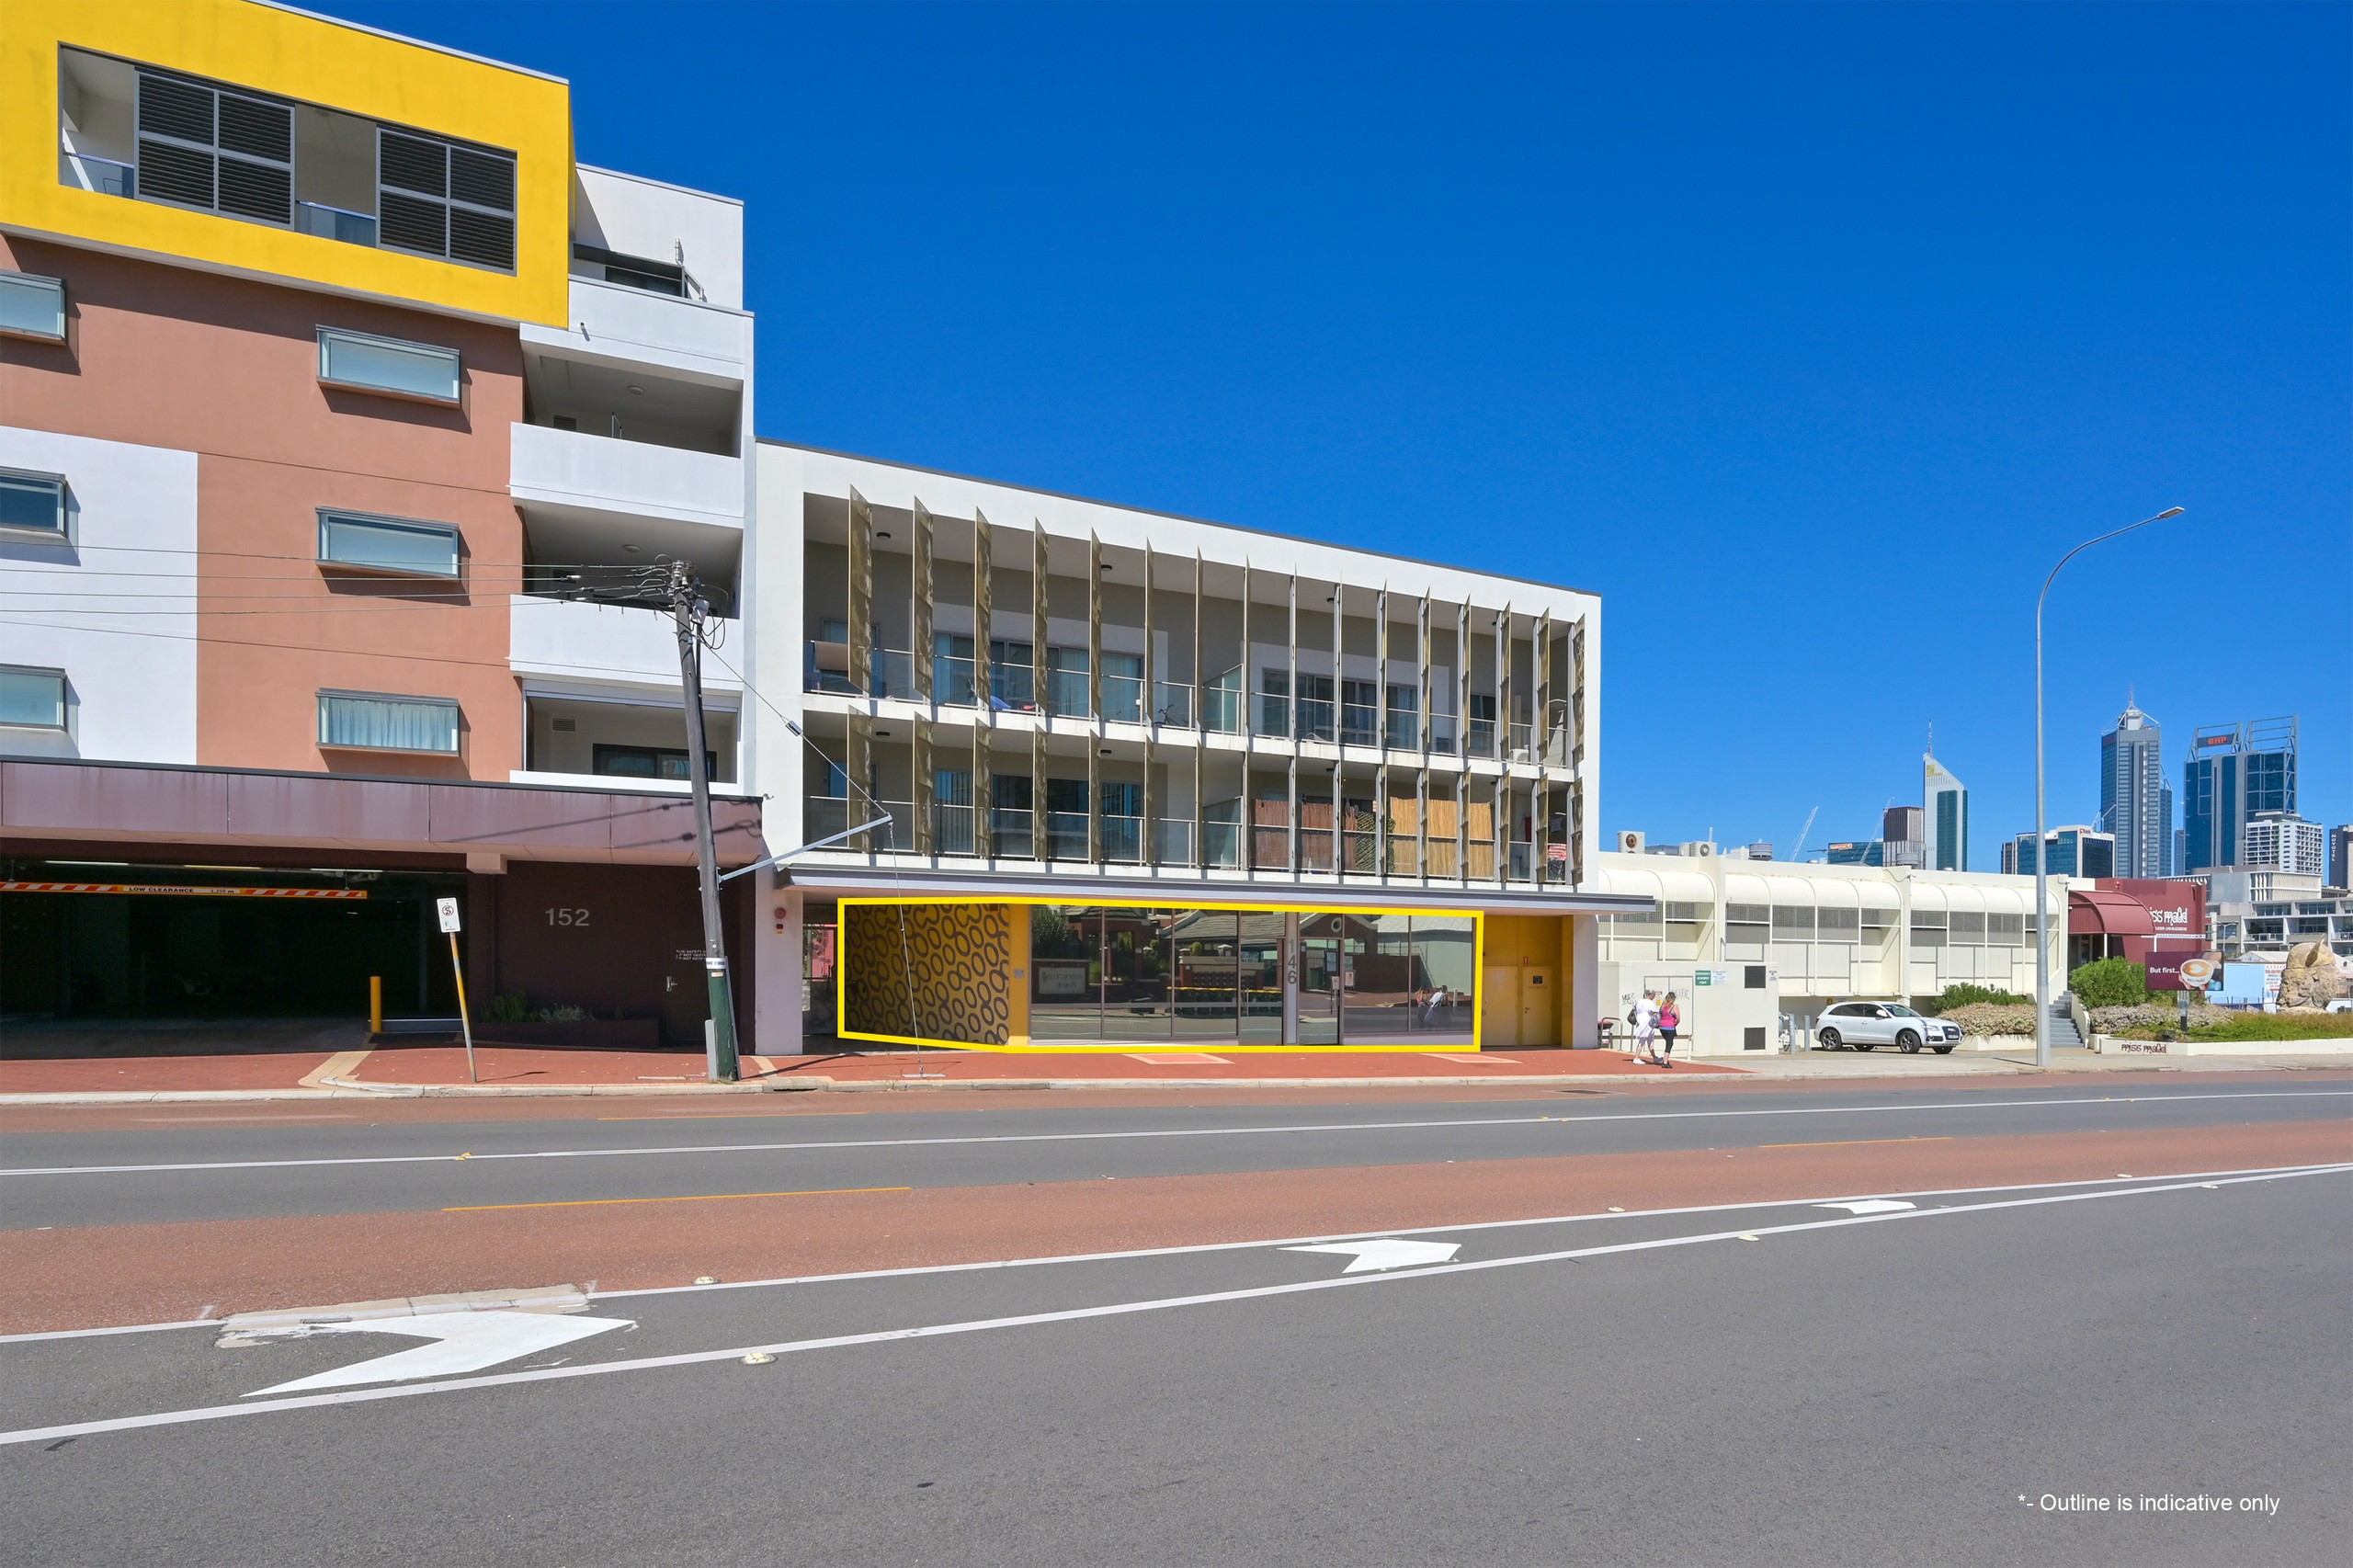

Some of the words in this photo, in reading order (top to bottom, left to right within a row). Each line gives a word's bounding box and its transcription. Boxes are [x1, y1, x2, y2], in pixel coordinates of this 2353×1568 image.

[2208, 736, 2227, 744] BHP
[545, 908, 589, 926] 152
[2121, 1042, 2142, 1052] miss
